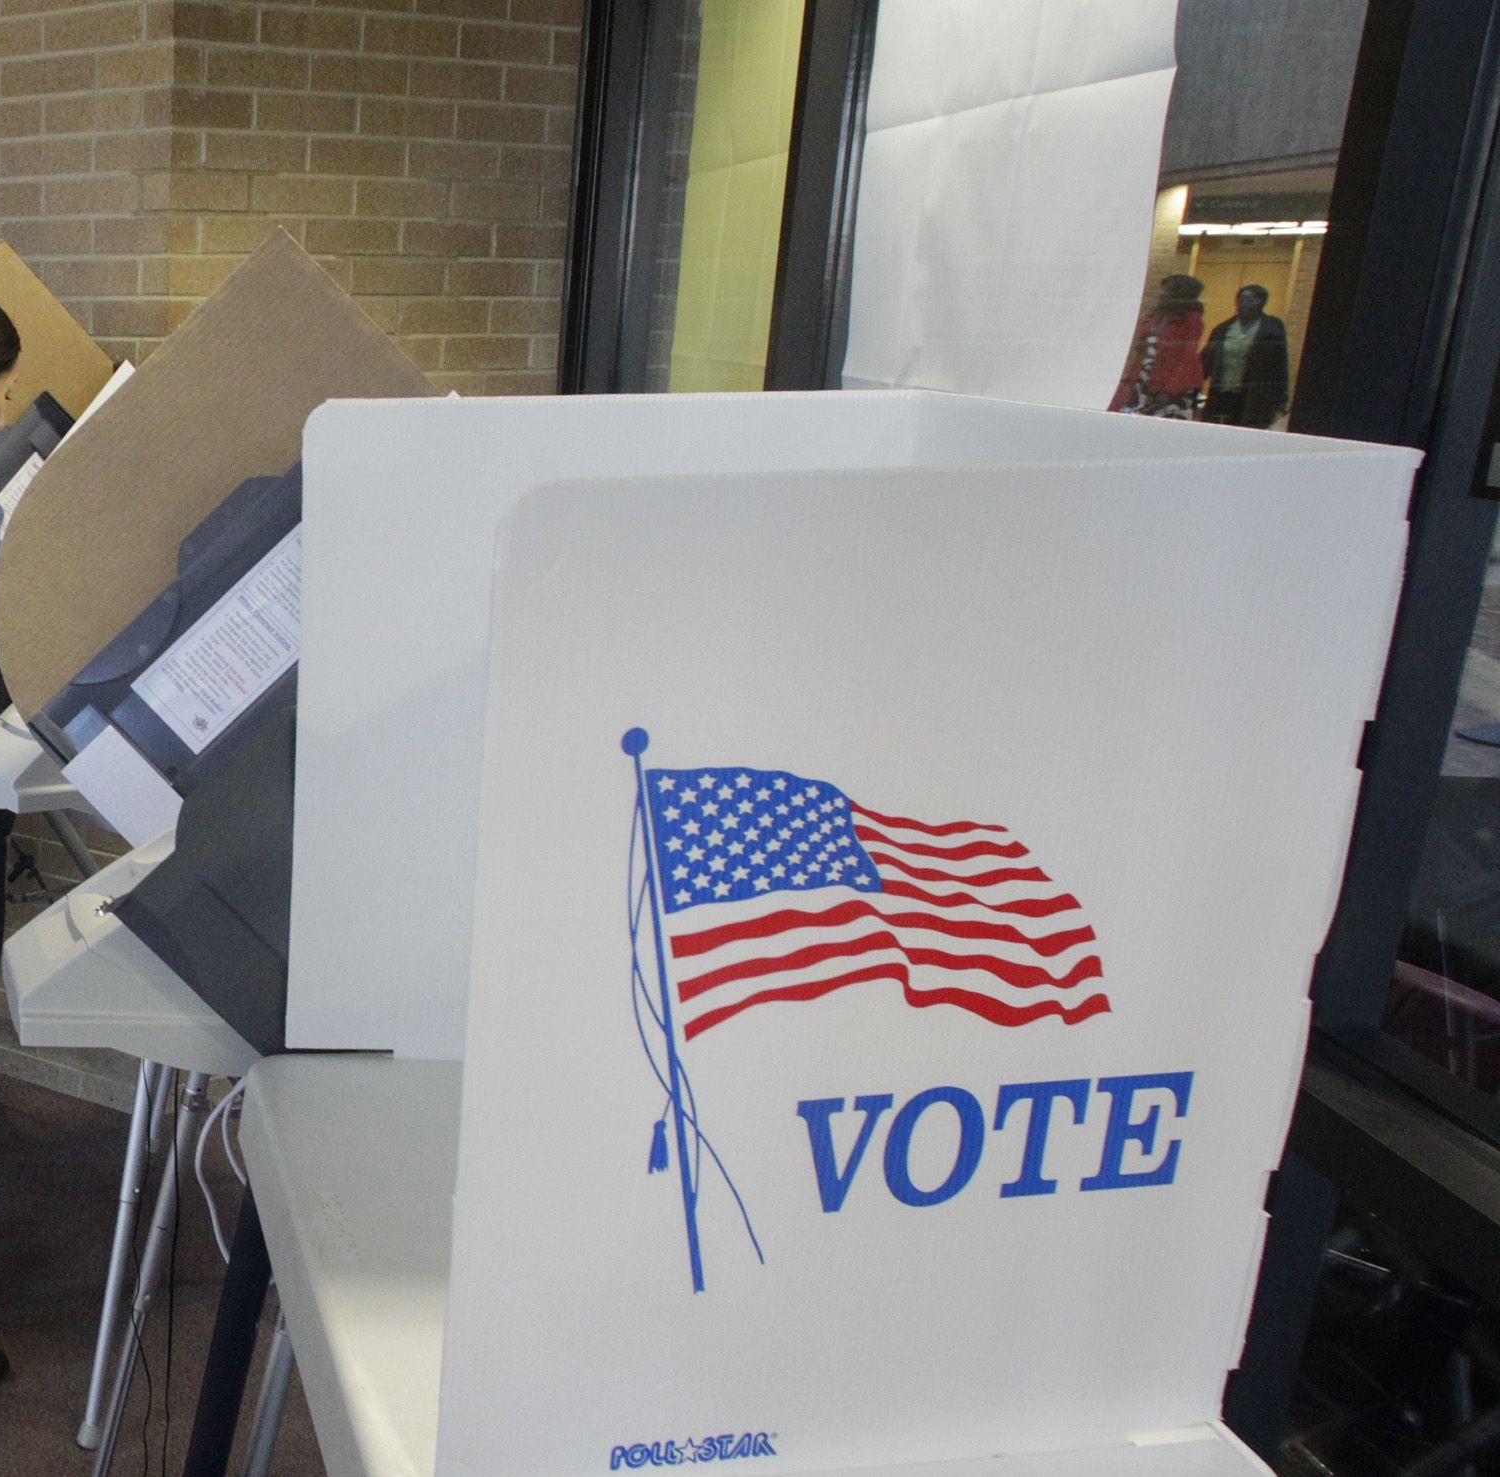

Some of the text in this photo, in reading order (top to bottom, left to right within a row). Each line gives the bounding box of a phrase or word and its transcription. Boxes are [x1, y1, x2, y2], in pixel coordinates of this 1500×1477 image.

[796, 1070, 1194, 1213] VOTE
[610, 1432, 777, 1470] POLL STAR
